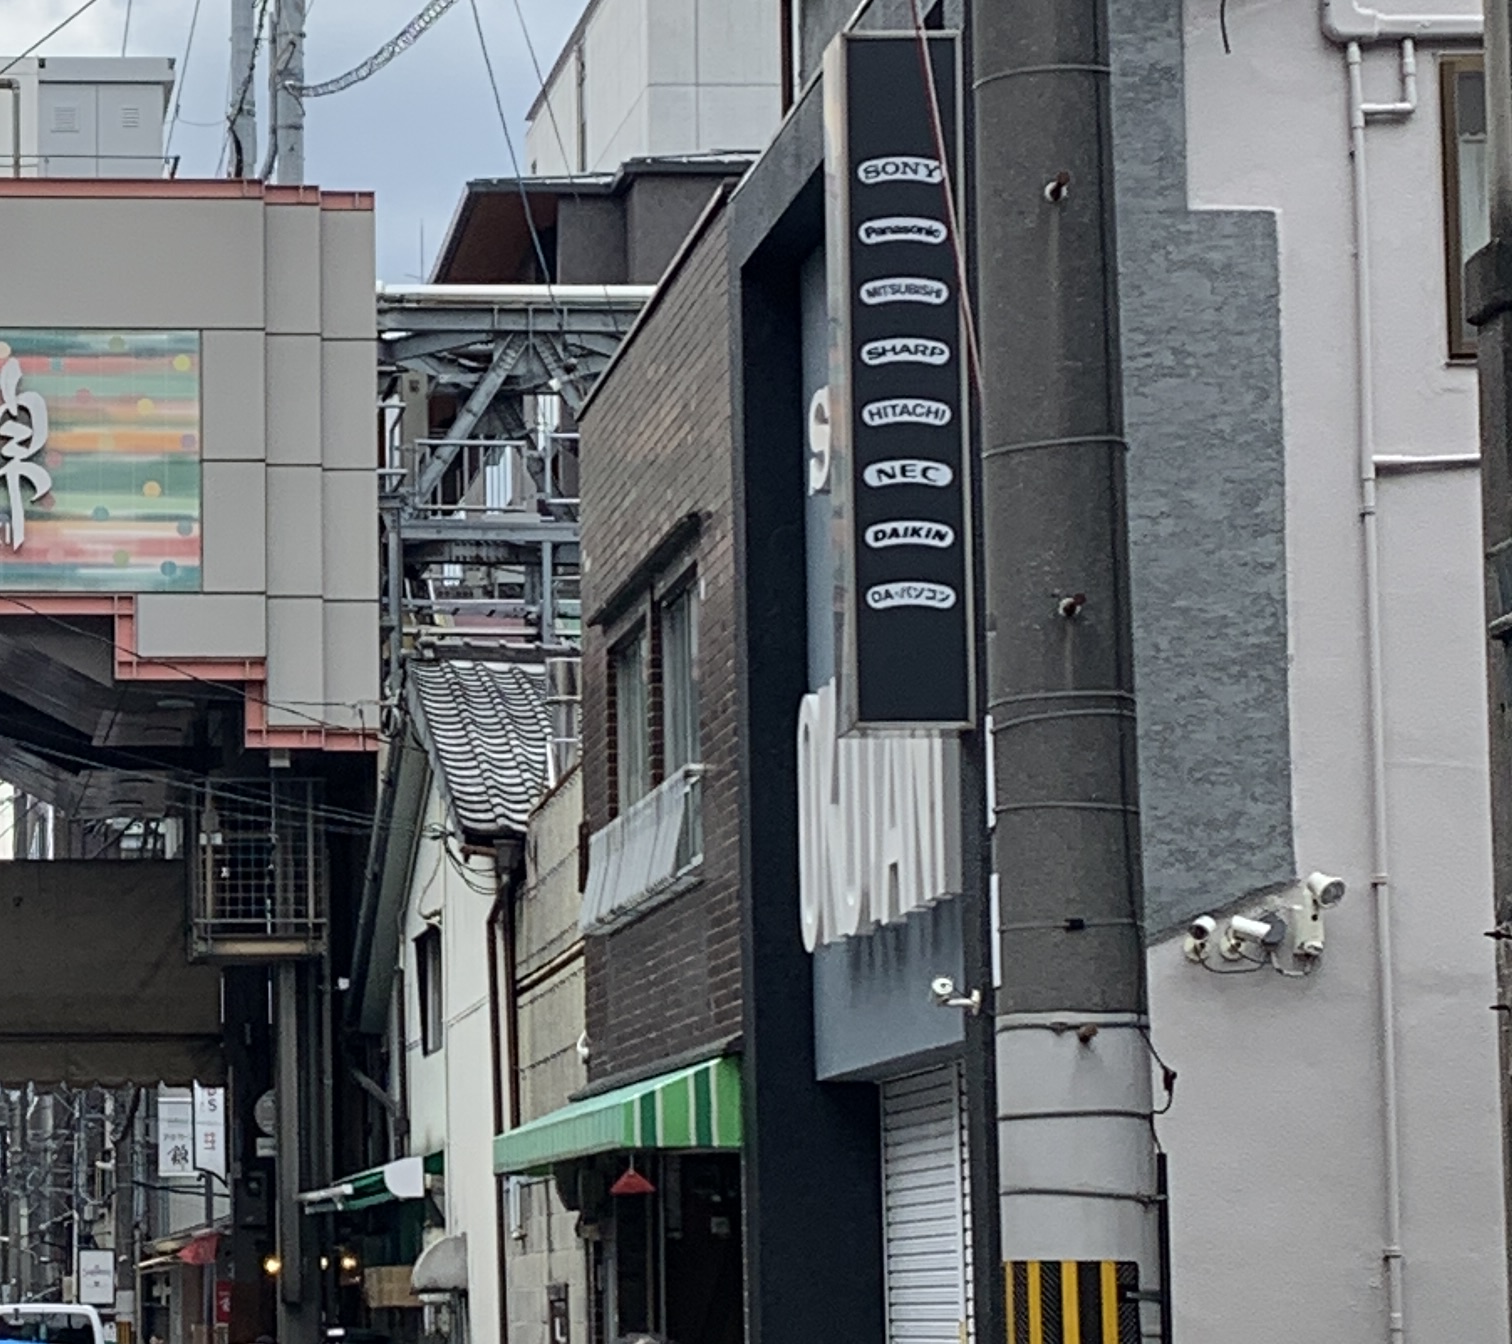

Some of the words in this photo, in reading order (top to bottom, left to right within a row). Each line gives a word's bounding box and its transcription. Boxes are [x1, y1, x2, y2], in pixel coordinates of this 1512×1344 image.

[863, 161, 940, 180] SONY
[864, 223, 942, 239] Panasonic
[865, 282, 943, 299] MITSUBISHI
[866, 343, 946, 360] SHARP
[867, 403, 947, 422] HITACHI
[875, 463, 941, 483] NEC
[873, 526, 949, 542] DAIKIN
